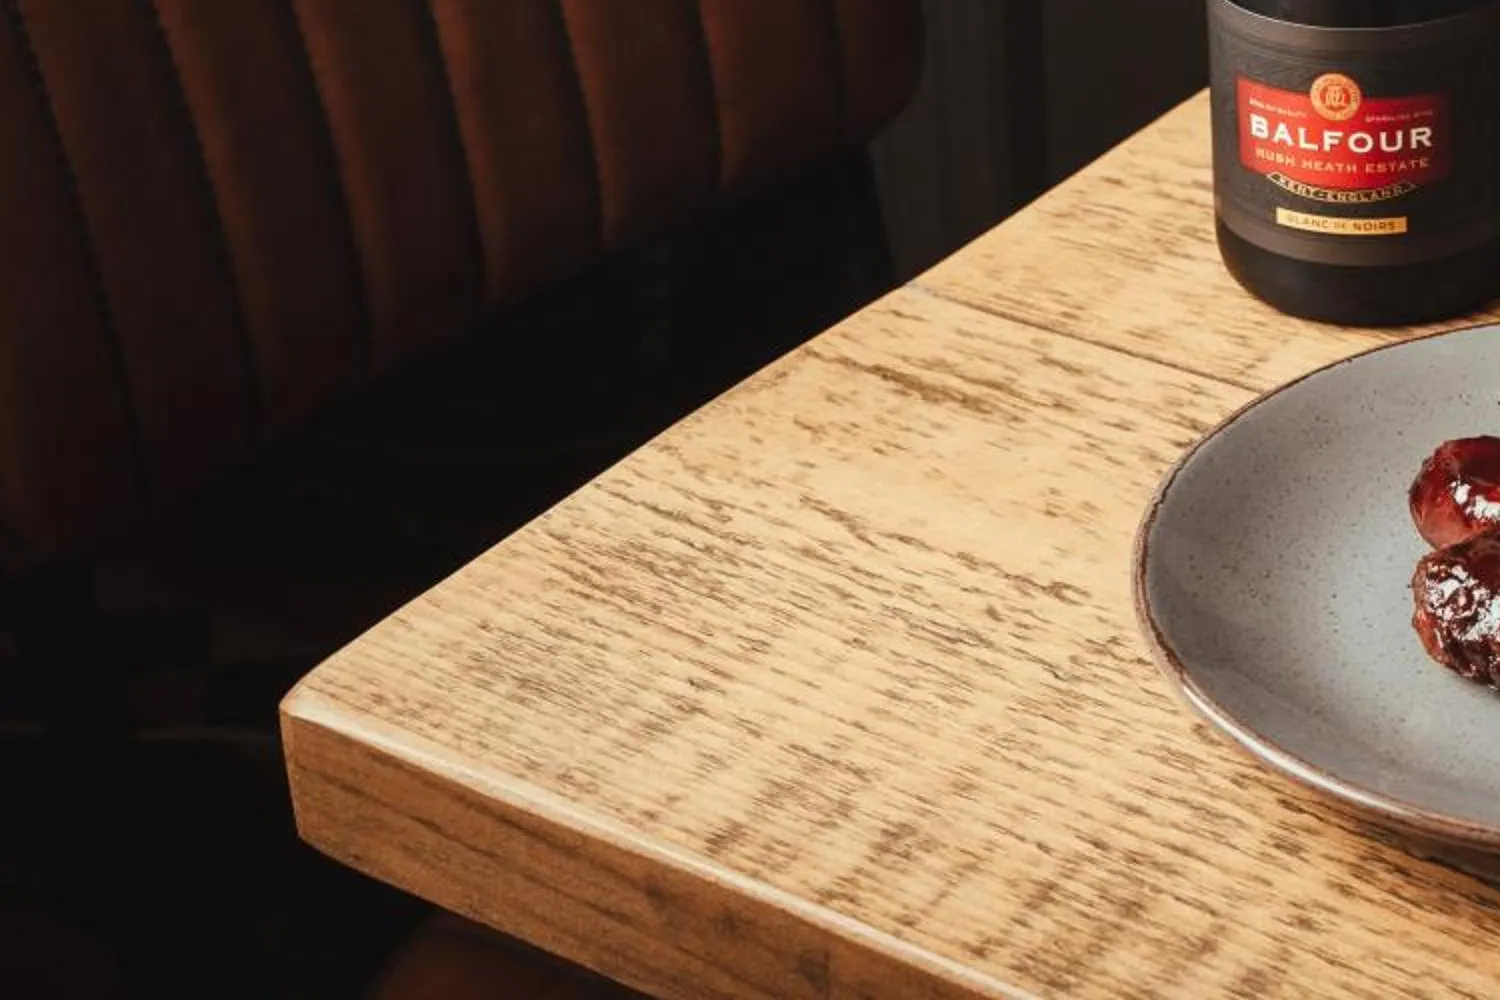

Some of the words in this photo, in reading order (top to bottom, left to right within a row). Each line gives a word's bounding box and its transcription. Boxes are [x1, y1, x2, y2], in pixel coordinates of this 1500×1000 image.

[1249, 113, 1432, 153] BALFOUR
[1301, 158, 1357, 173] HEATH
[1365, 157, 1430, 173] ESTATE
[1352, 221, 1395, 232] NOIRS
